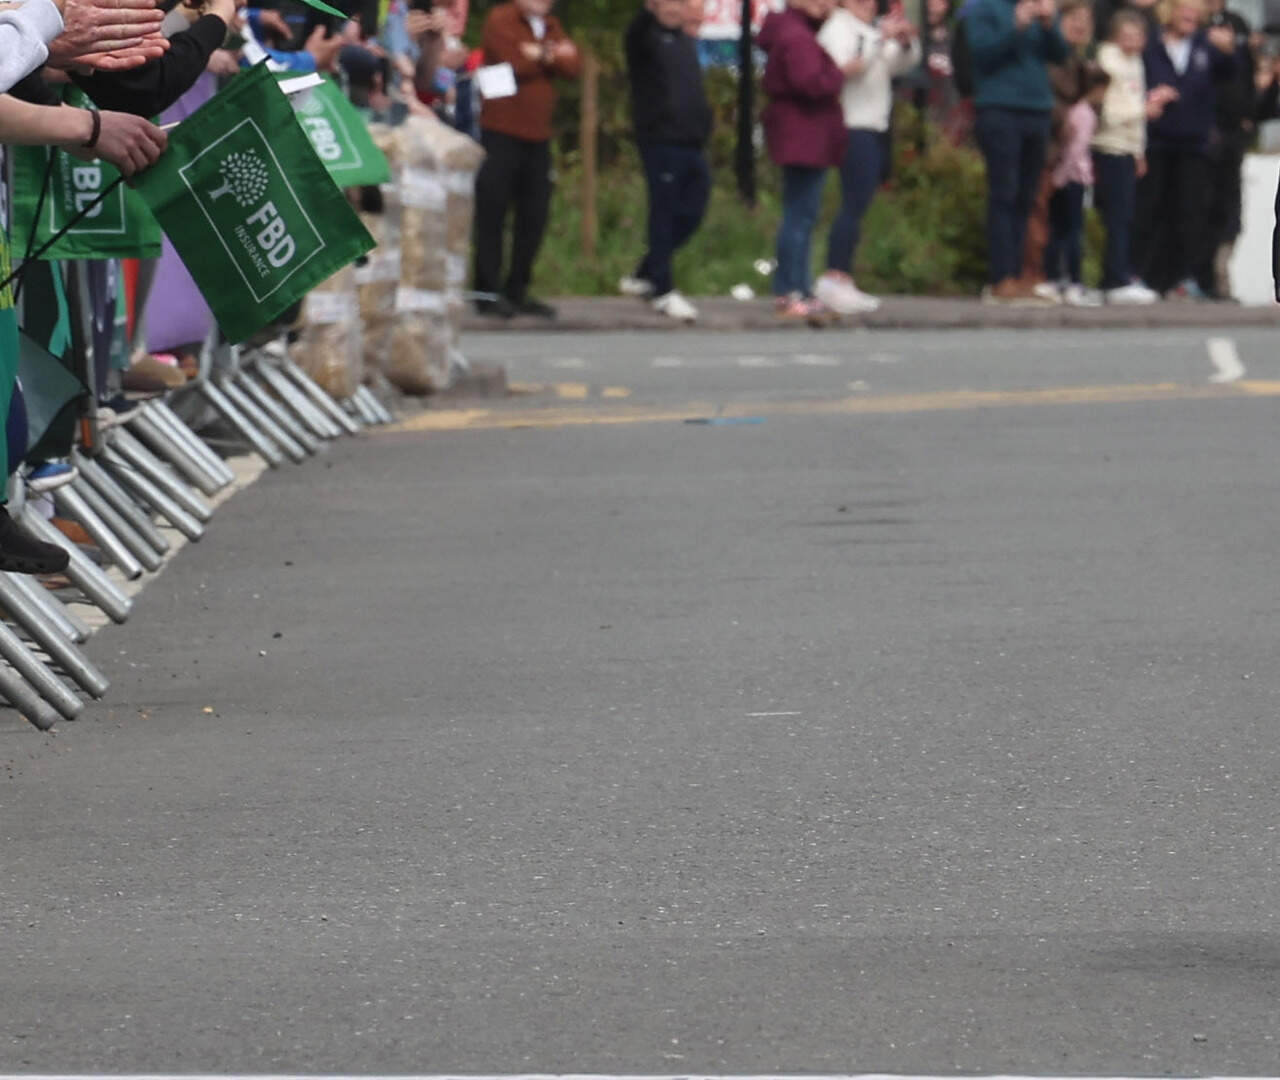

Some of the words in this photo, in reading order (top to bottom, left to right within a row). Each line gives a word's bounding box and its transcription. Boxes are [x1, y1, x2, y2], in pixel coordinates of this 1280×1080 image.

[73, 158, 104, 218] BD
[233, 224, 270, 279] INSURANCE
[246, 200, 296, 268] FBD
